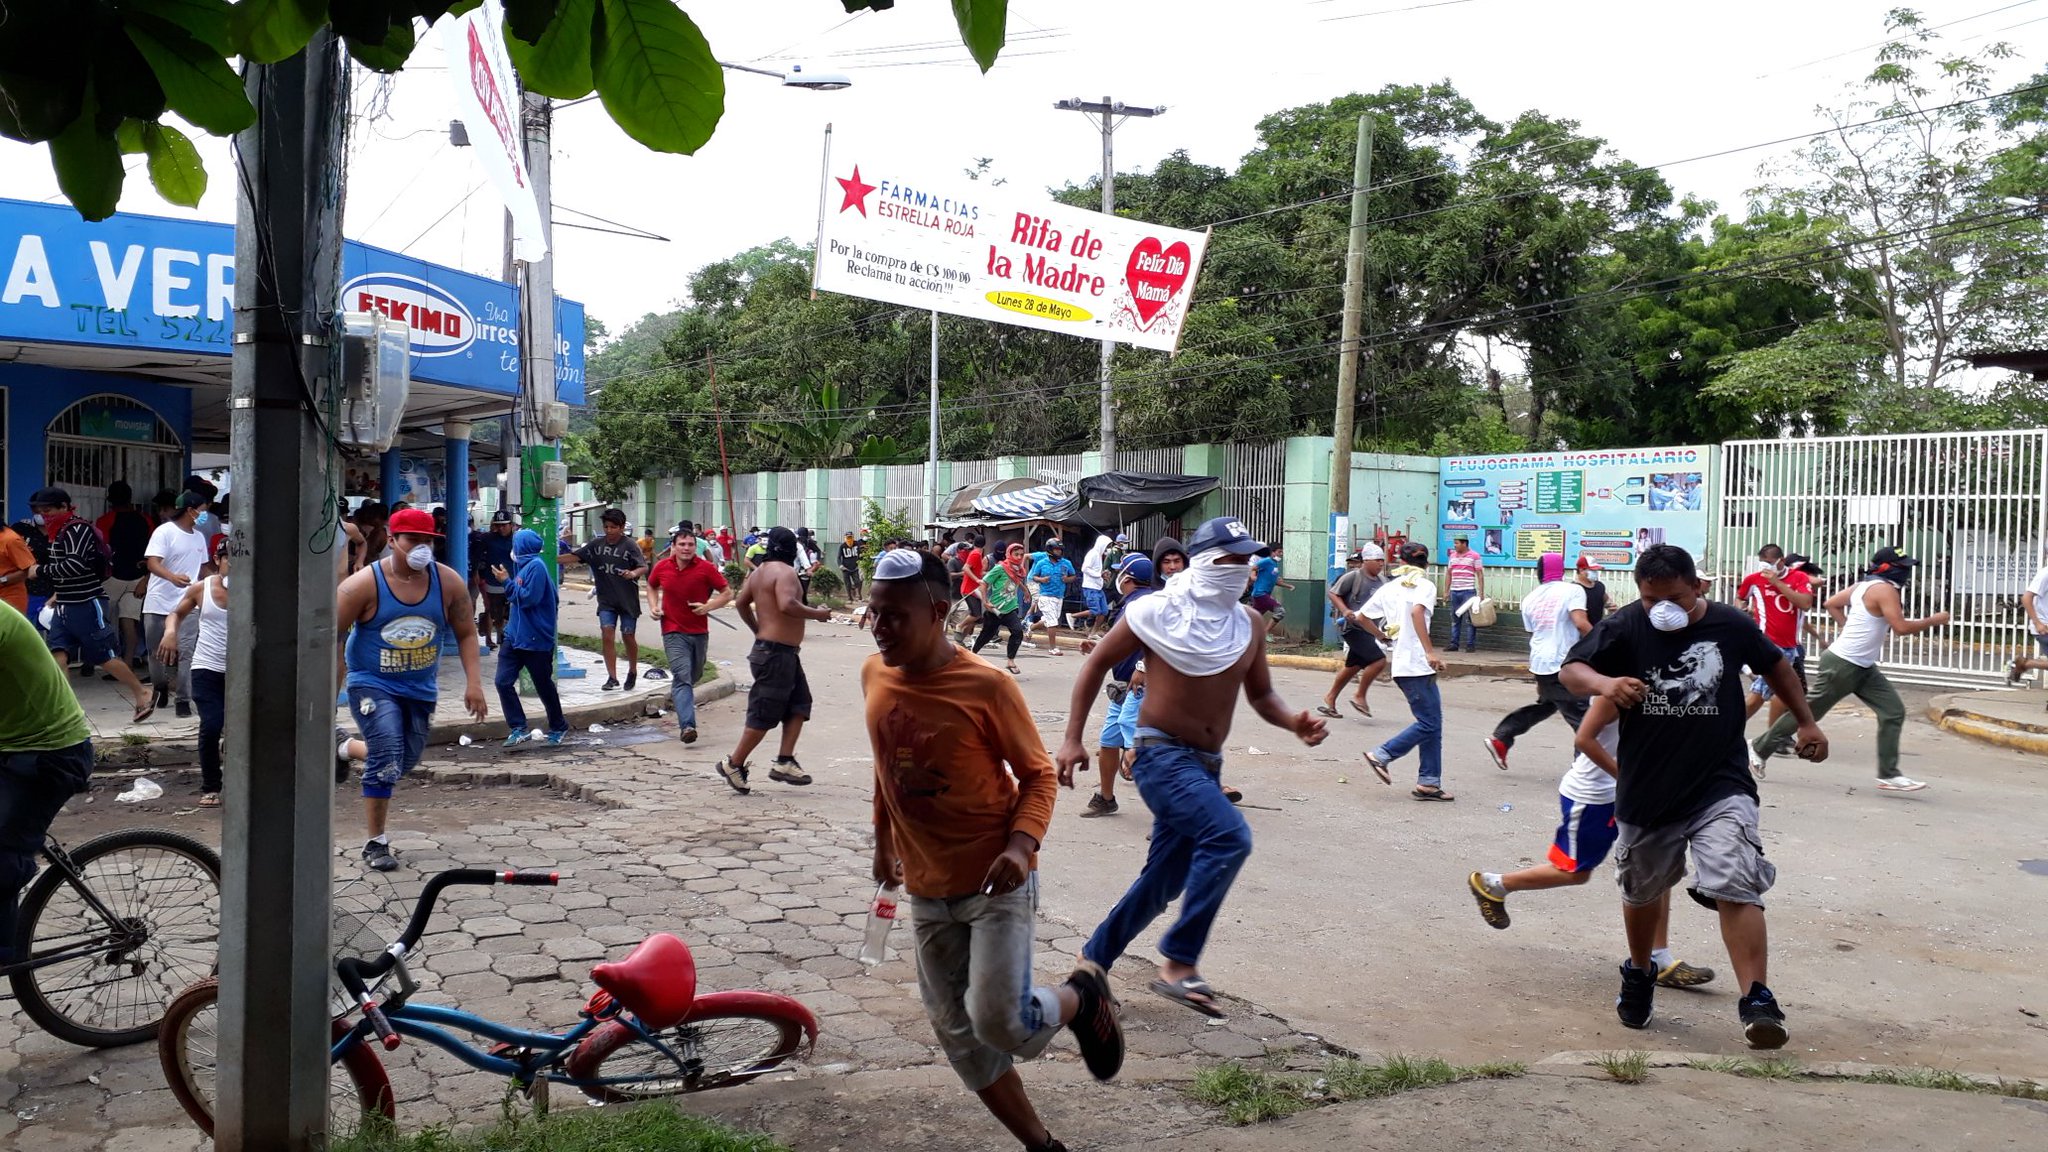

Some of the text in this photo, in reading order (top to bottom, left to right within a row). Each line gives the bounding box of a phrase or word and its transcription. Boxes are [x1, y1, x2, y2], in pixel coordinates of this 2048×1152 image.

[878, 200, 975, 238] ESTRELLA ROJA
[880, 180, 979, 220] FARMACIAS
[1010, 212, 1103, 260] Rifa de
[2, 234, 61, 308] A
[830, 239, 850, 256] Por
[852, 245, 862, 260] la
[865, 251, 907, 270] compra
[910, 260, 923, 274] de
[926, 263, 940, 278] C$
[987, 244, 1106, 297] la Madre
[895, 273, 906, 286] tu
[1136, 280, 1171, 303] Mamá
[358, 291, 461, 339] ESKIMO
[996, 292, 1072, 320] Lunes 28 de Mayo
[1450, 450, 1698, 472] FLUJOGRAMA HOSPITALARIO
[1643, 691, 1669, 705] The
